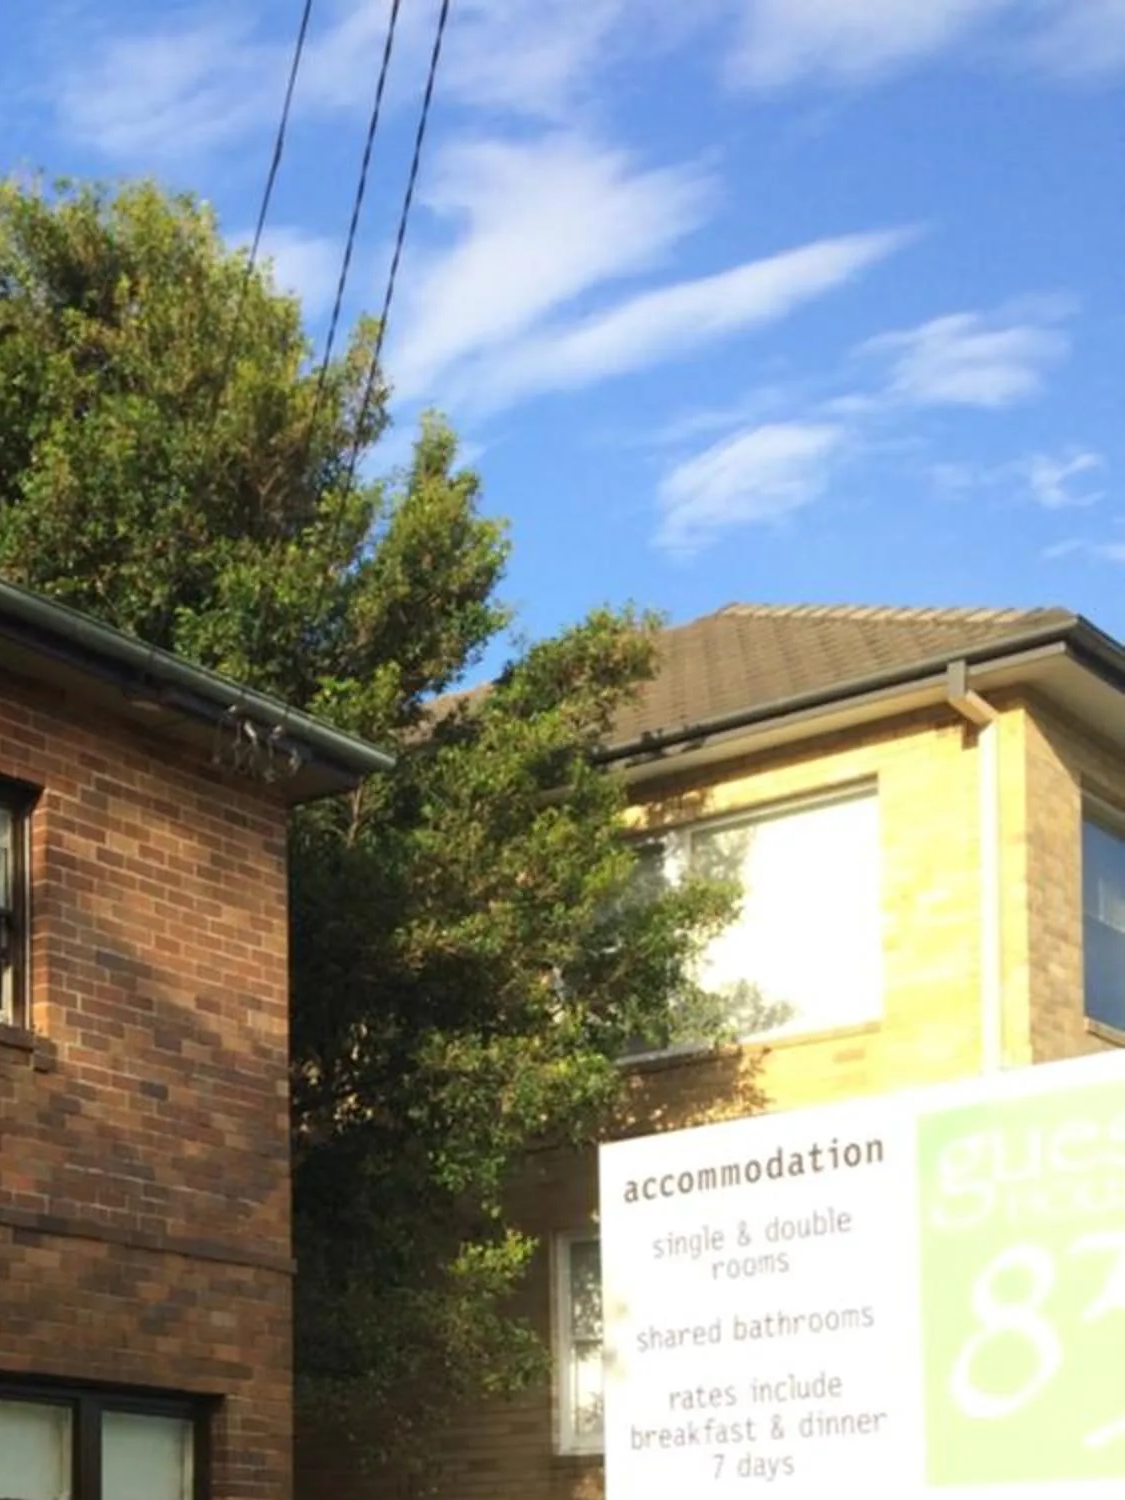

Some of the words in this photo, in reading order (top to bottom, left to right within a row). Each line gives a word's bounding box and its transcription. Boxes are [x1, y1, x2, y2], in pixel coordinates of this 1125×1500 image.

[622, 1136, 885, 1204] accommodation
[652, 1224, 725, 1260] single
[736, 1219, 753, 1248] &
[764, 1206, 853, 1244] double
[711, 1250, 790, 1281] rooms
[636, 1317, 722, 1354] shared
[732, 1304, 875, 1343] bathrooms
[668, 1384, 738, 1412] rates
[750, 1370, 844, 1404] include
[630, 1418, 757, 1451] breakfast
[769, 1413, 786, 1441] &
[798, 1409, 889, 1439] dinner
[711, 1452, 726, 1481] 7
[736, 1451, 796, 1484] days
